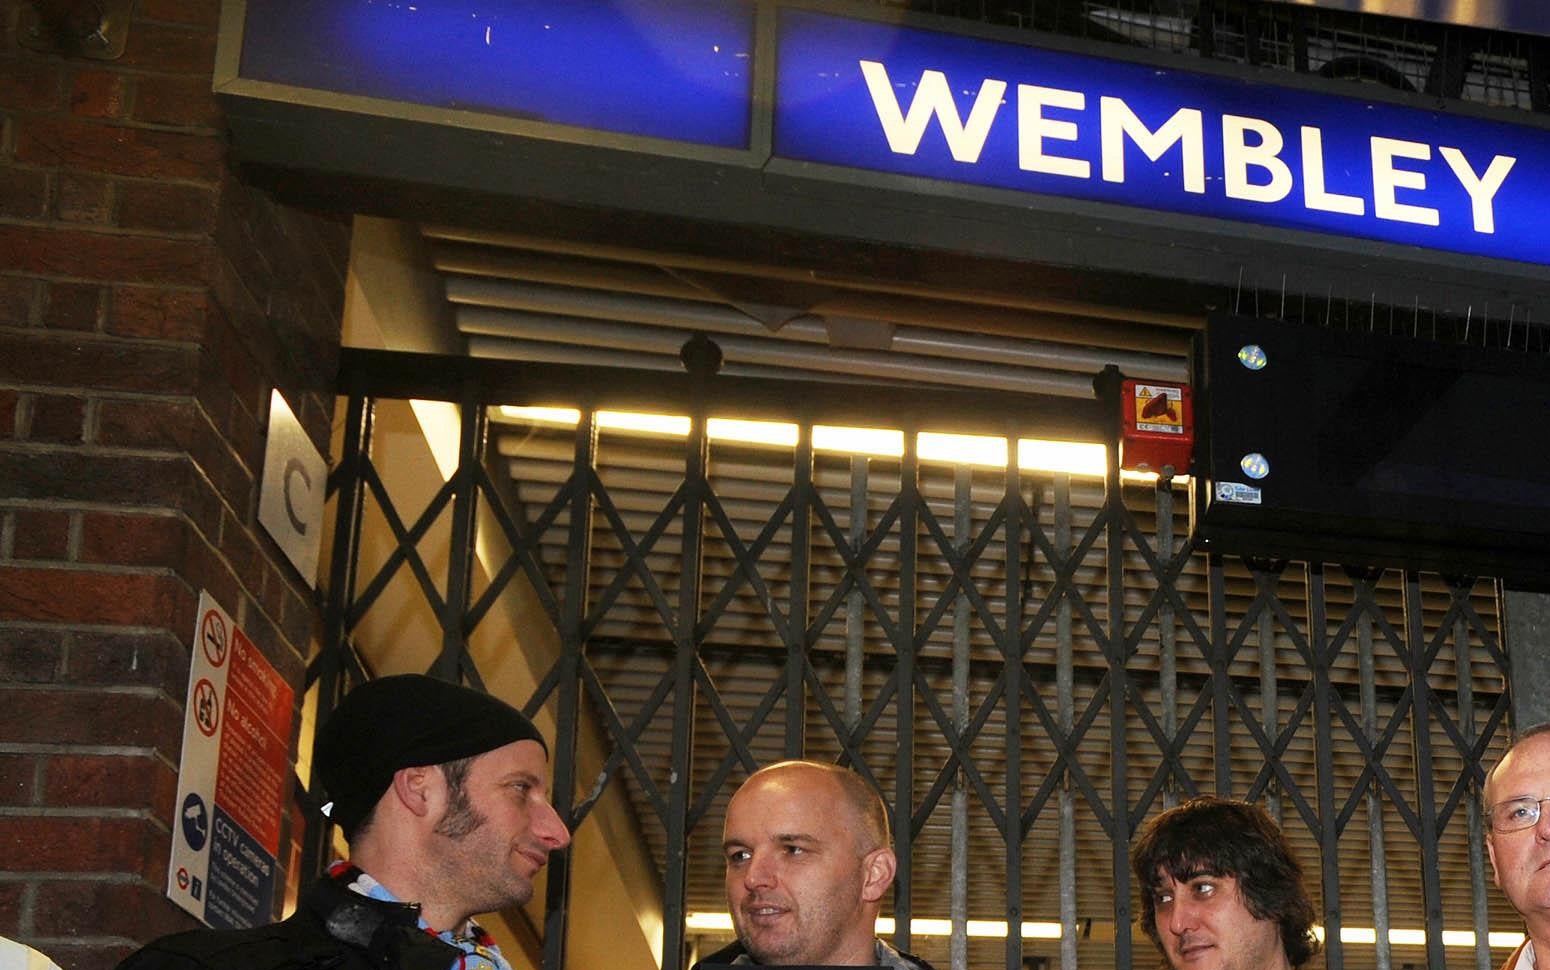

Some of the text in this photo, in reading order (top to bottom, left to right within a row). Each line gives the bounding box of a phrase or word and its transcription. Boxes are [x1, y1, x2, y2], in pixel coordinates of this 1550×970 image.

[859, 59, 1517, 234] WEMBLEY
[284, 457, 311, 536] C
[215, 818, 240, 847] CCTV
